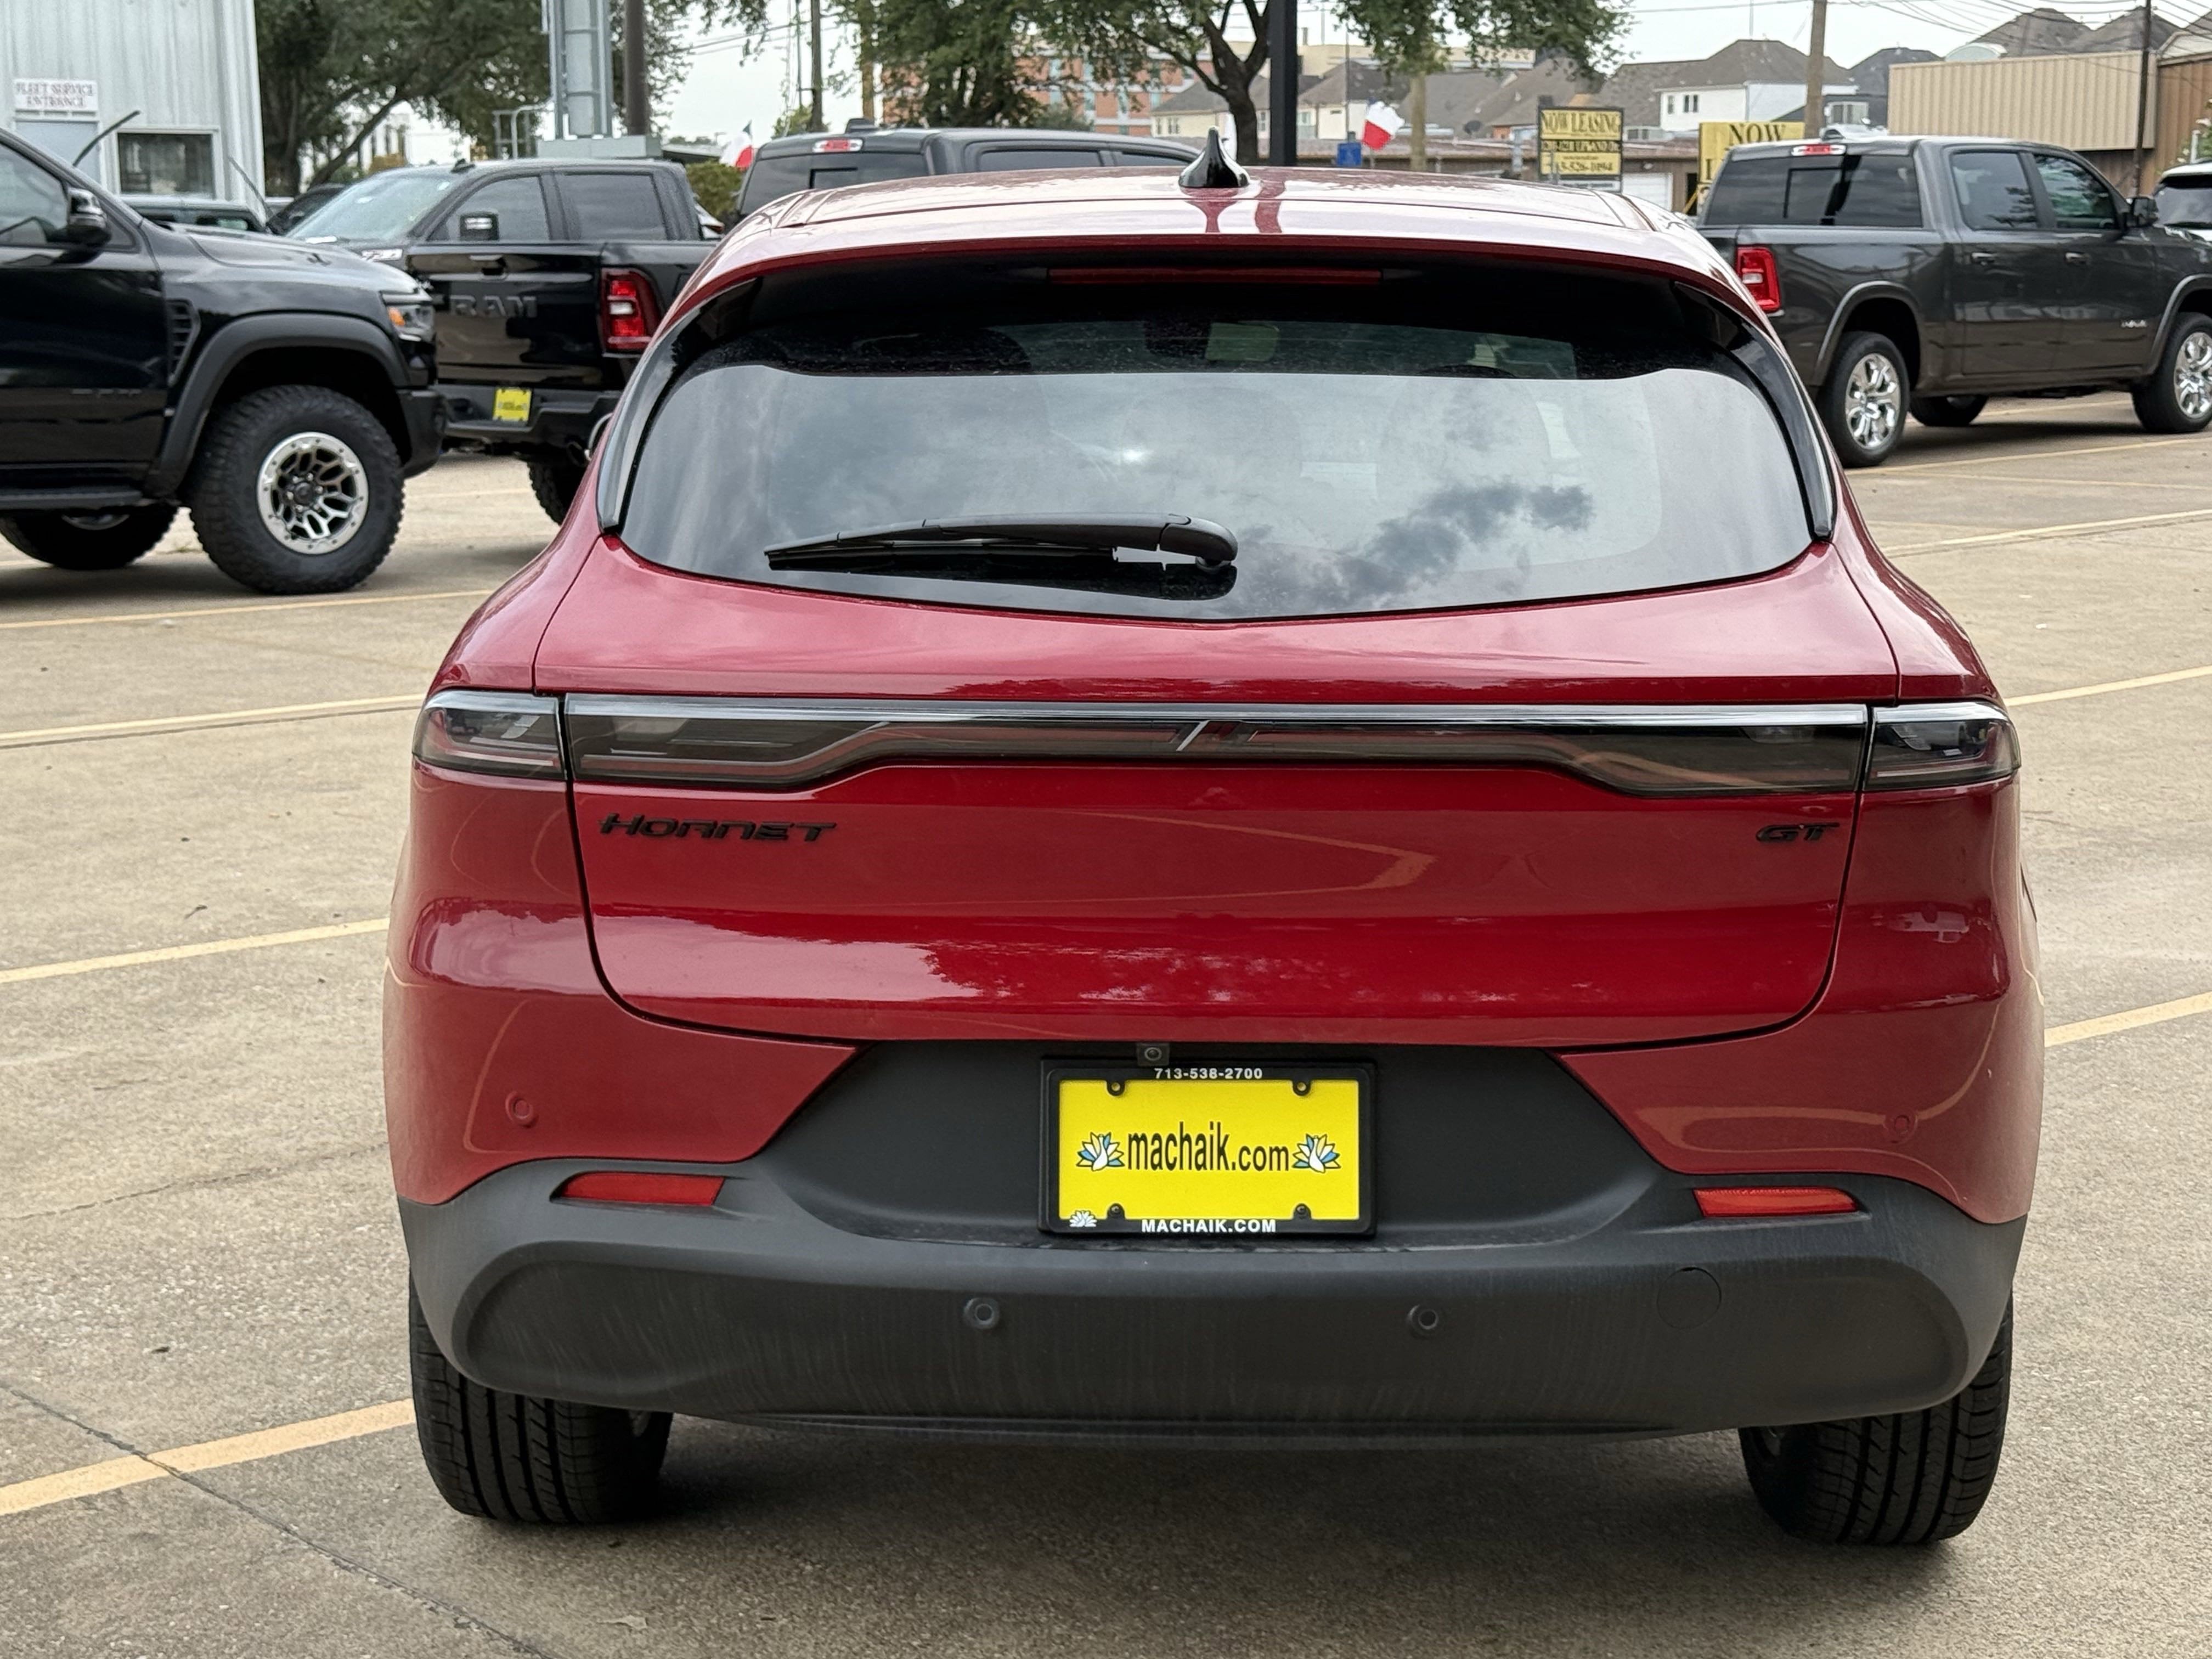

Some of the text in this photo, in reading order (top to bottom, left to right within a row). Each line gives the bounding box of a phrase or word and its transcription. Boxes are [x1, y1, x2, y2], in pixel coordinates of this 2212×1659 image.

[1542, 112, 1621, 133] NOW LEASING
[1729, 123, 1786, 145] NOW
[449, 294, 537, 318] RAM
[599, 812, 837, 842] HORNET
[1756, 822, 1840, 842] GT
[1154, 1068, 1262, 1079] 713-538-2700
[1127, 1121, 1289, 1171] machaik.com
[1141, 1219, 1276, 1233] MACHAIK.COM
